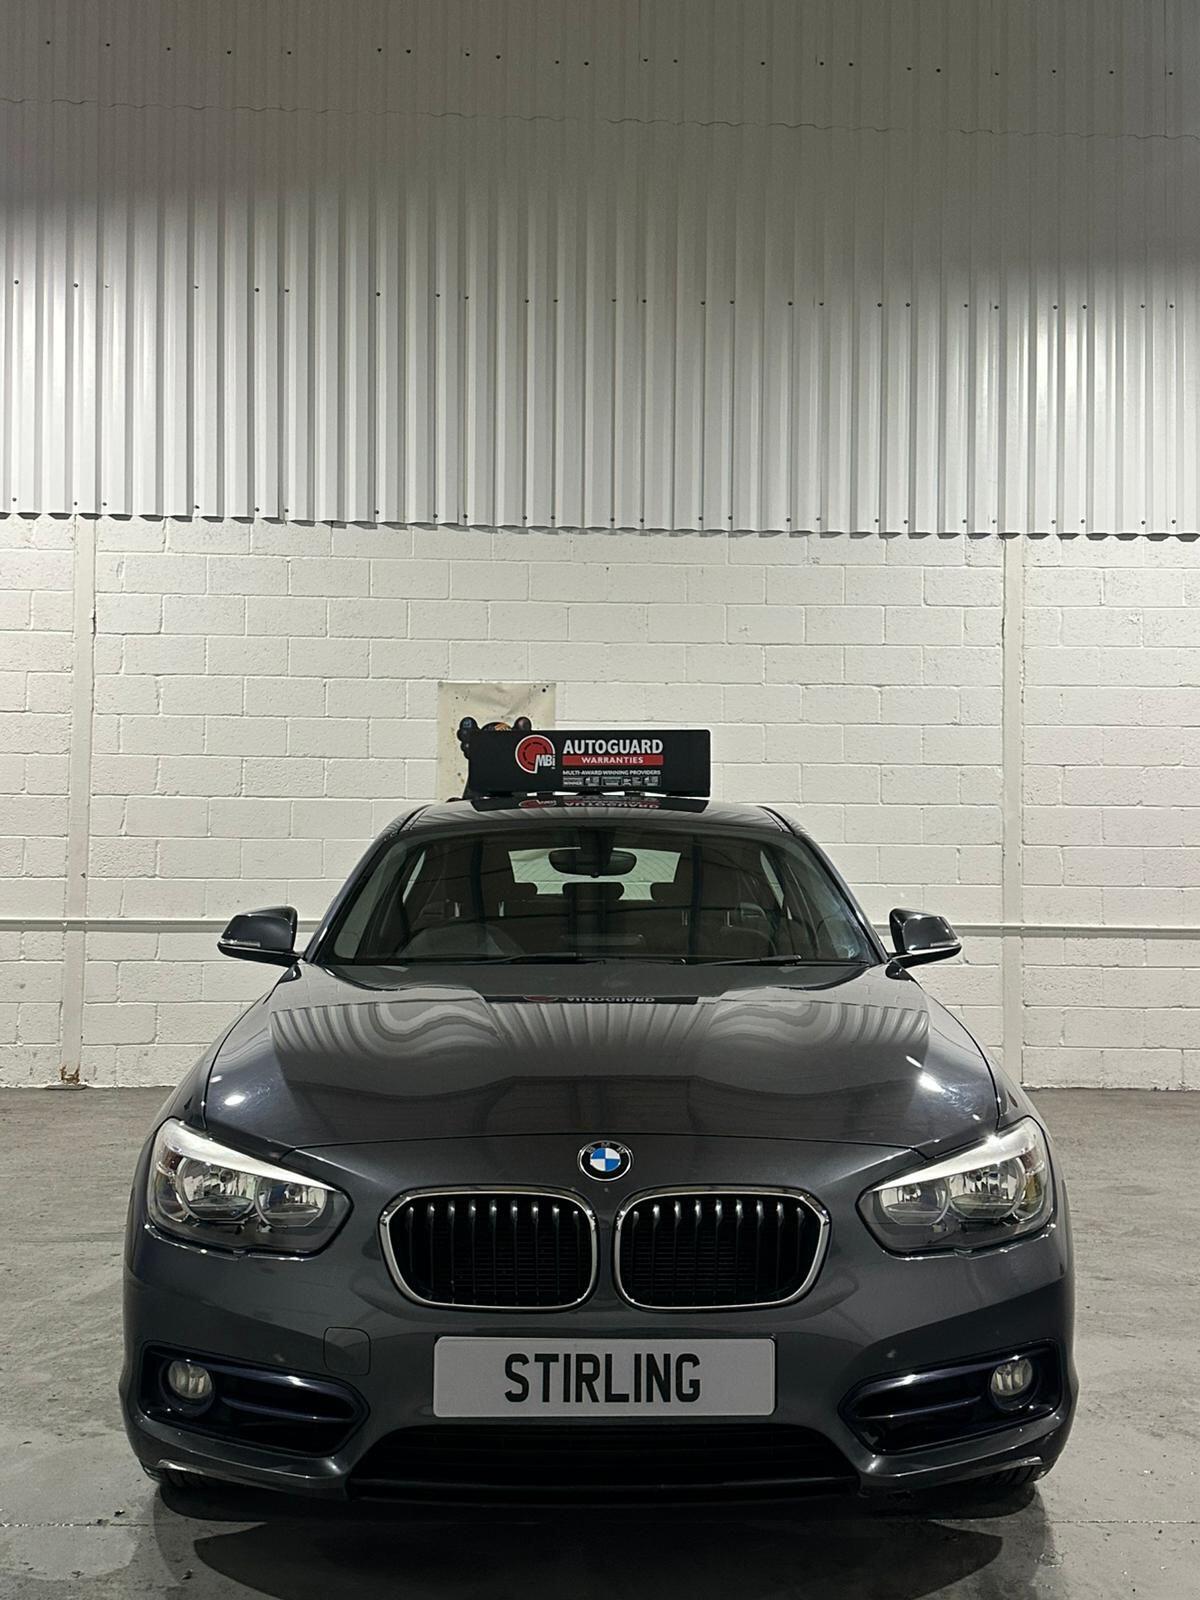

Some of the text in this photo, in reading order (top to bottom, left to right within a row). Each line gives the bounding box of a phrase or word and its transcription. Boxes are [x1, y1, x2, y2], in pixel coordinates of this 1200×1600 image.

[563, 739, 663, 754] AUTOGUARD
[581, 756, 644, 764] WARRANTIES
[504, 1353, 701, 1403] STIRLING
